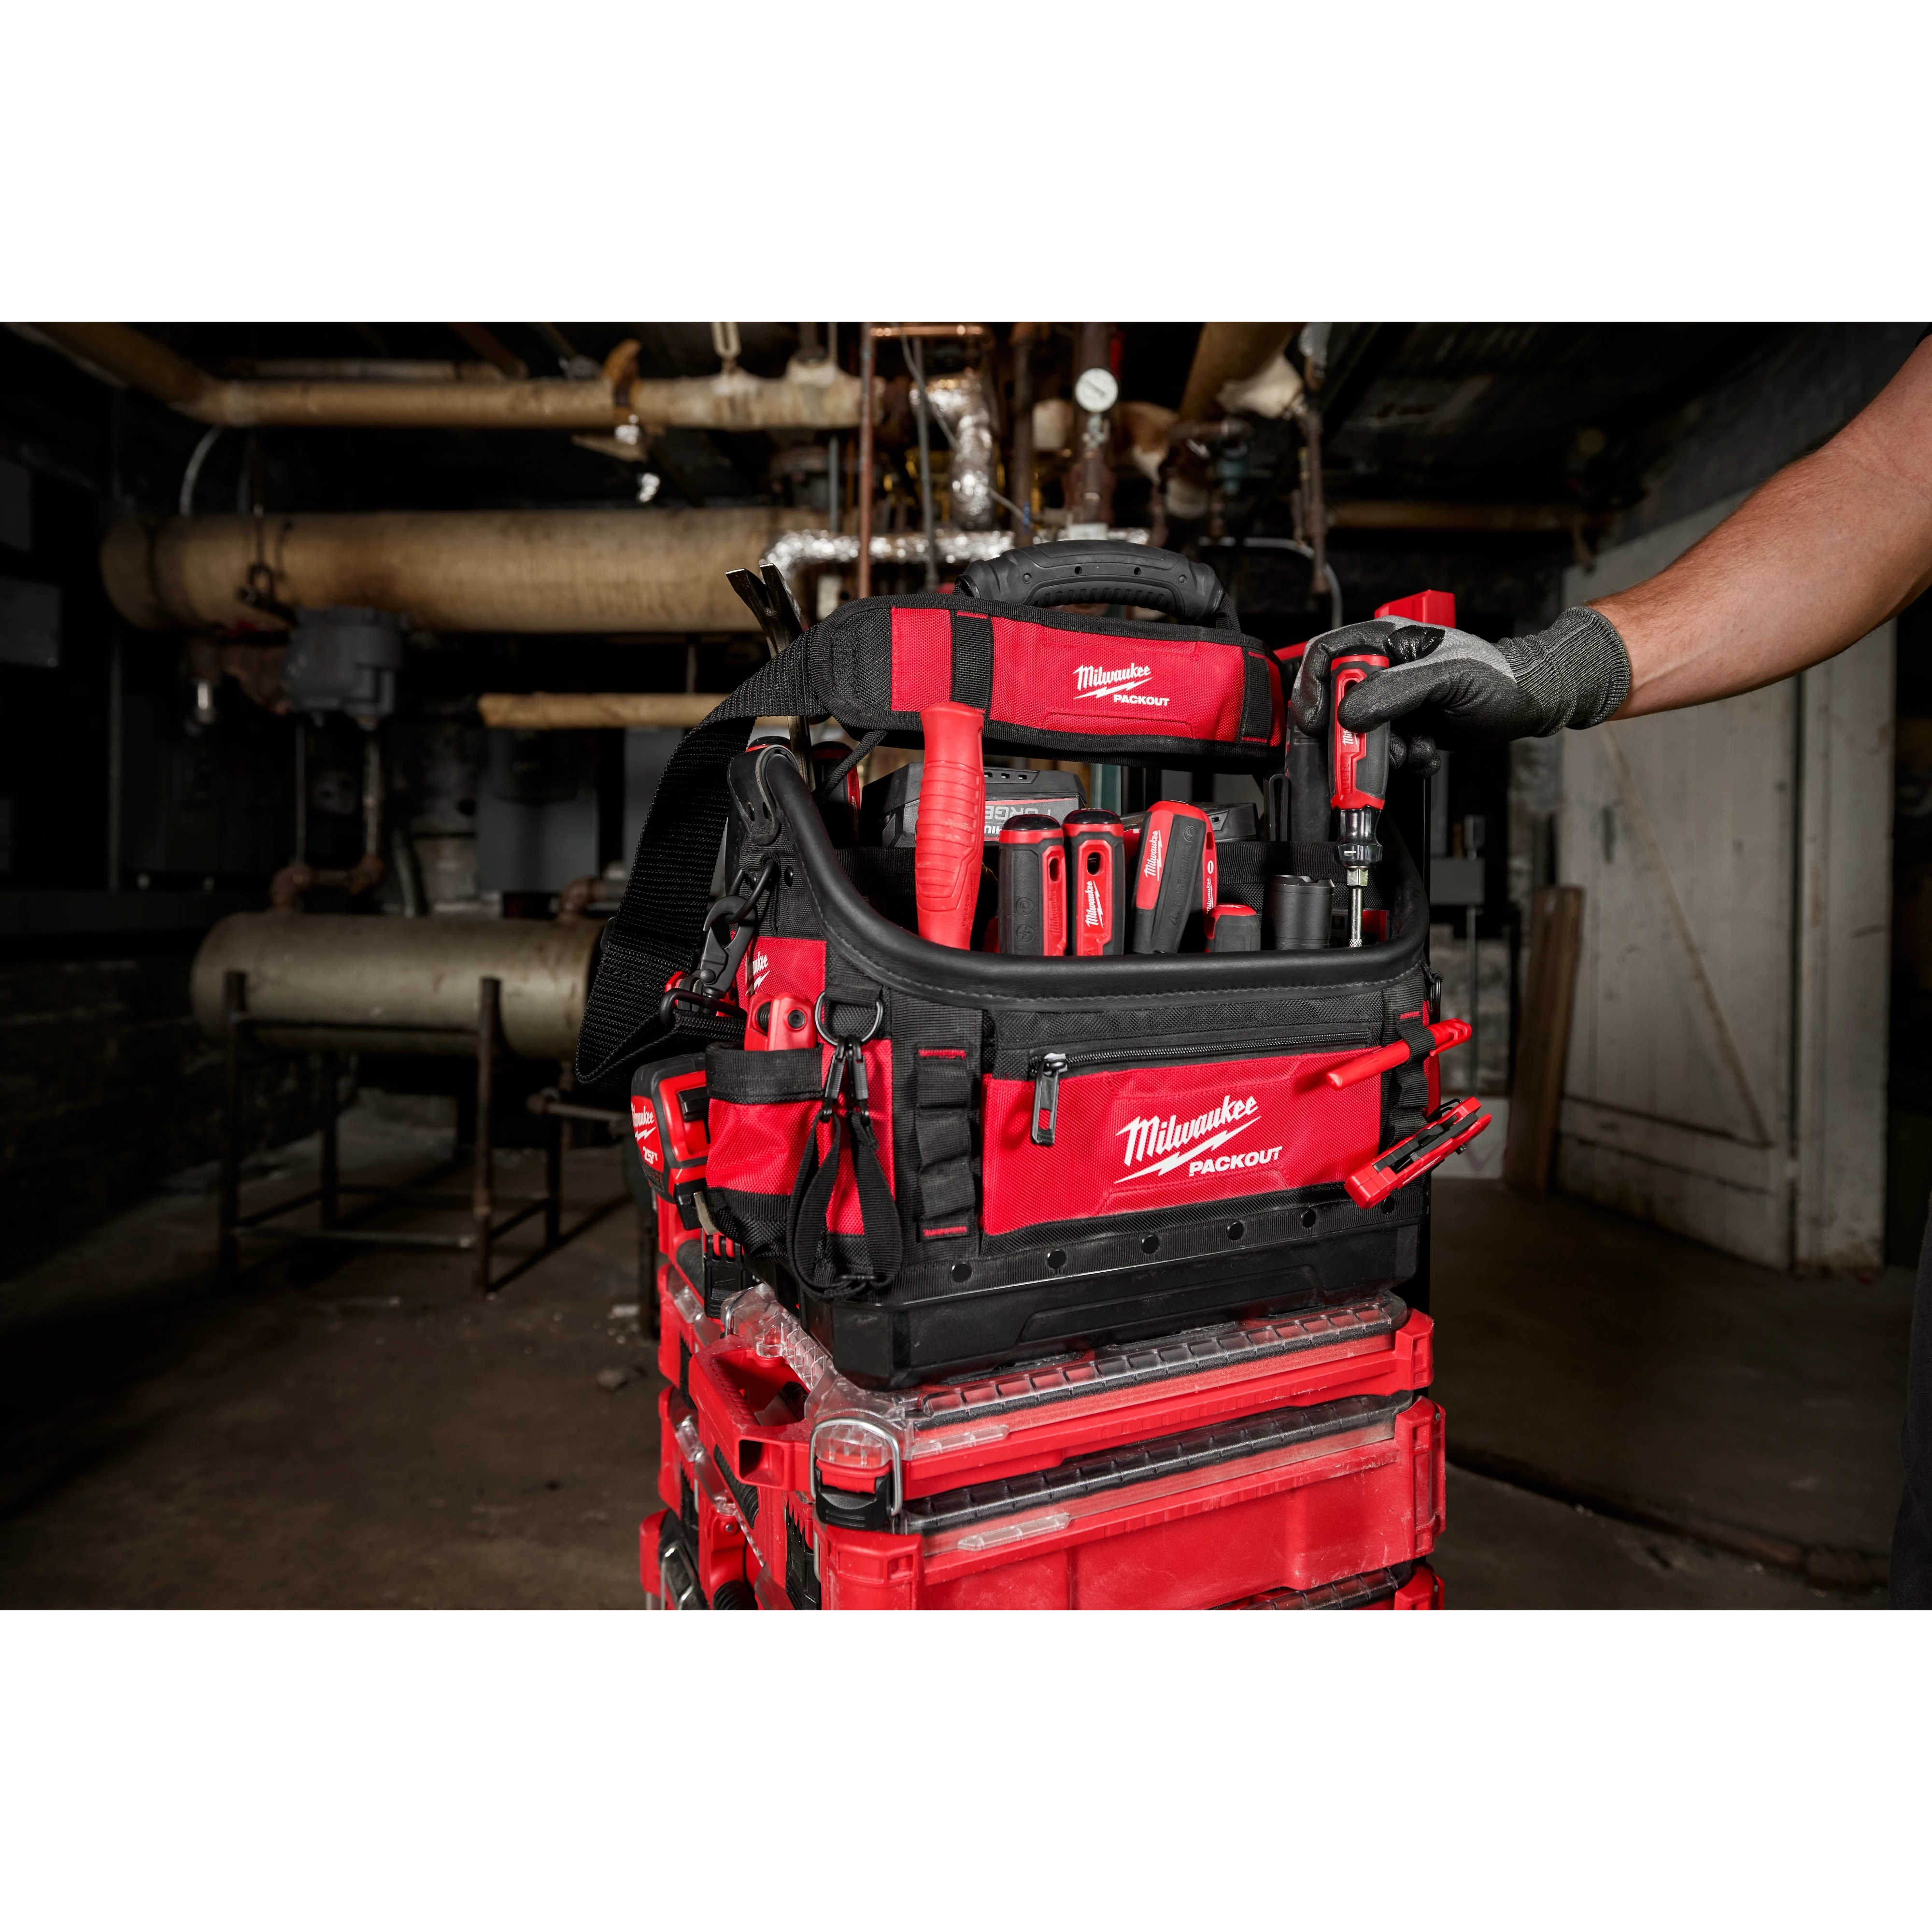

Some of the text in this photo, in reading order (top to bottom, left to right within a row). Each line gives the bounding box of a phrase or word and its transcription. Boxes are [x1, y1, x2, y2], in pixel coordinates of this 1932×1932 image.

[1073, 663, 1151, 691] Milwaukee
[1113, 694, 1169, 706] PACKOUT
[1144, 829, 1158, 878] Milwaukee
[1085, 881, 1099, 927] Milwaukee
[1116, 1095, 1258, 1166] Milwaukee
[1189, 1146, 1282, 1177] PACKOUT
